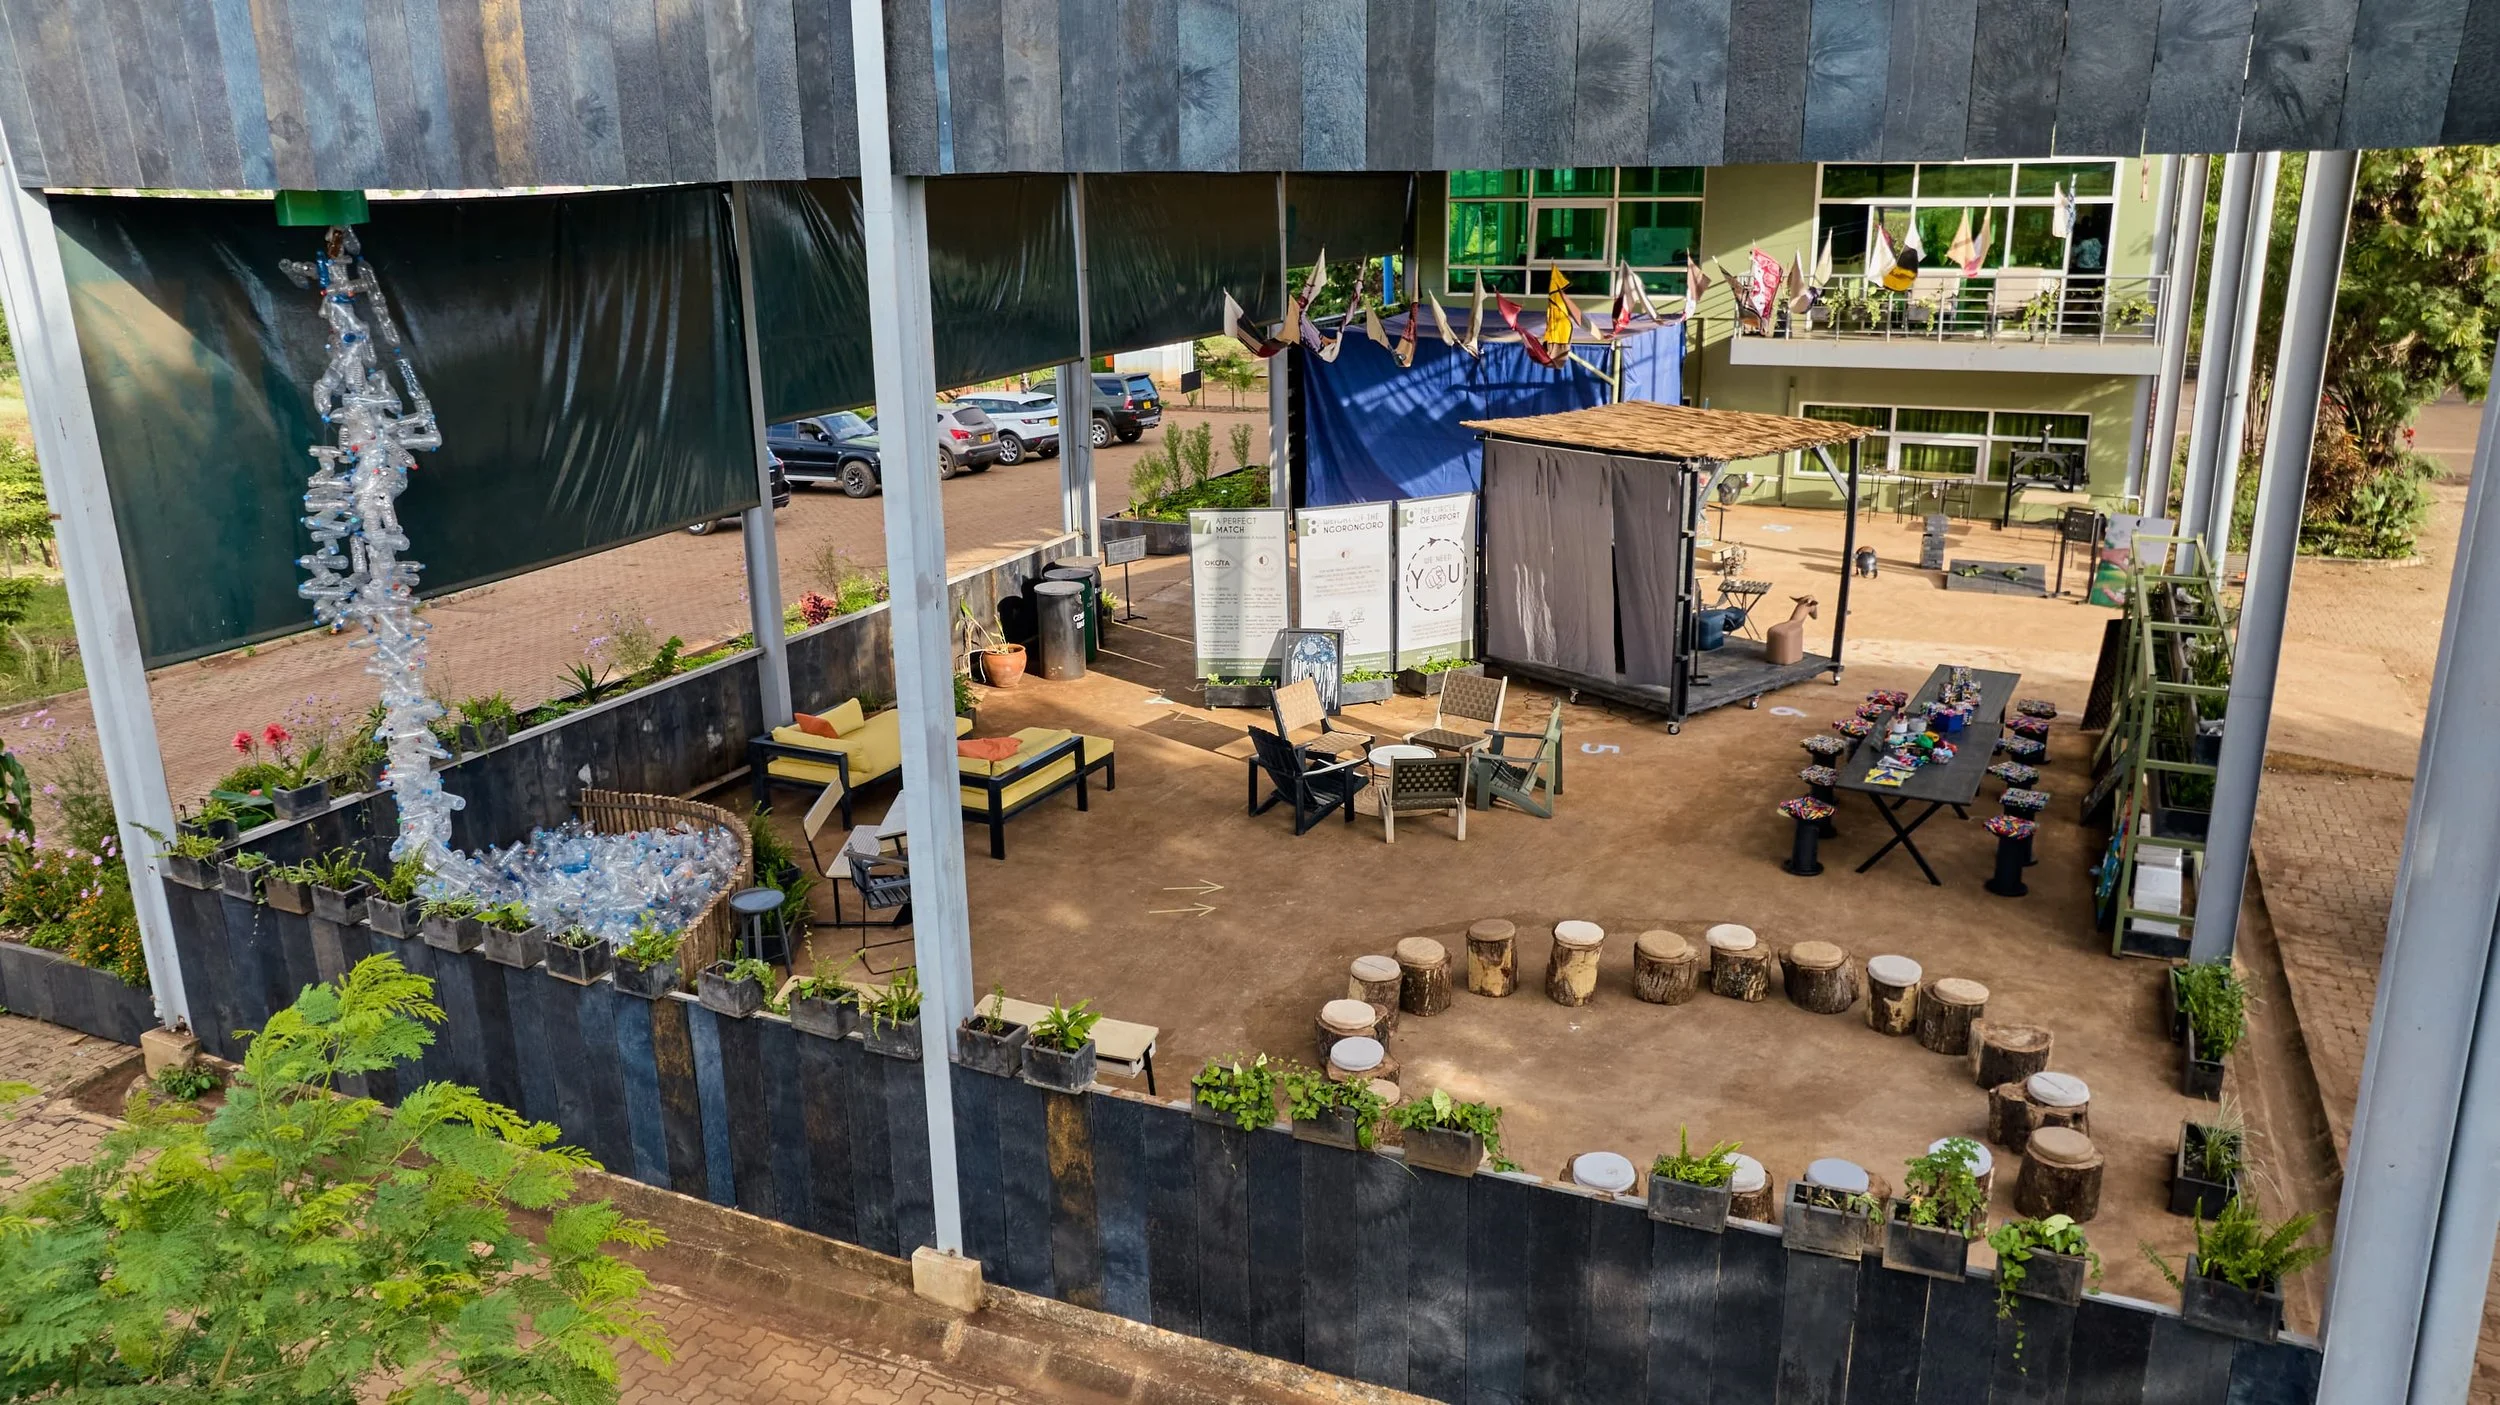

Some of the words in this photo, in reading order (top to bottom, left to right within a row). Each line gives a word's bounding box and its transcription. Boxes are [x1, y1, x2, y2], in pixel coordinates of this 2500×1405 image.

[1222, 517, 1257, 525] PERFECT
[1406, 509, 1415, 526] 9
[1431, 512, 1460, 522] SUPPORT
[1216, 526, 1245, 534] MATCH
[1307, 518, 1319, 536] 8
[1323, 521, 1384, 534] NGORONGORO
[1423, 555, 1432, 564] WE
[1435, 553, 1452, 562] NEED
[1581, 743, 1620, 754] 5
